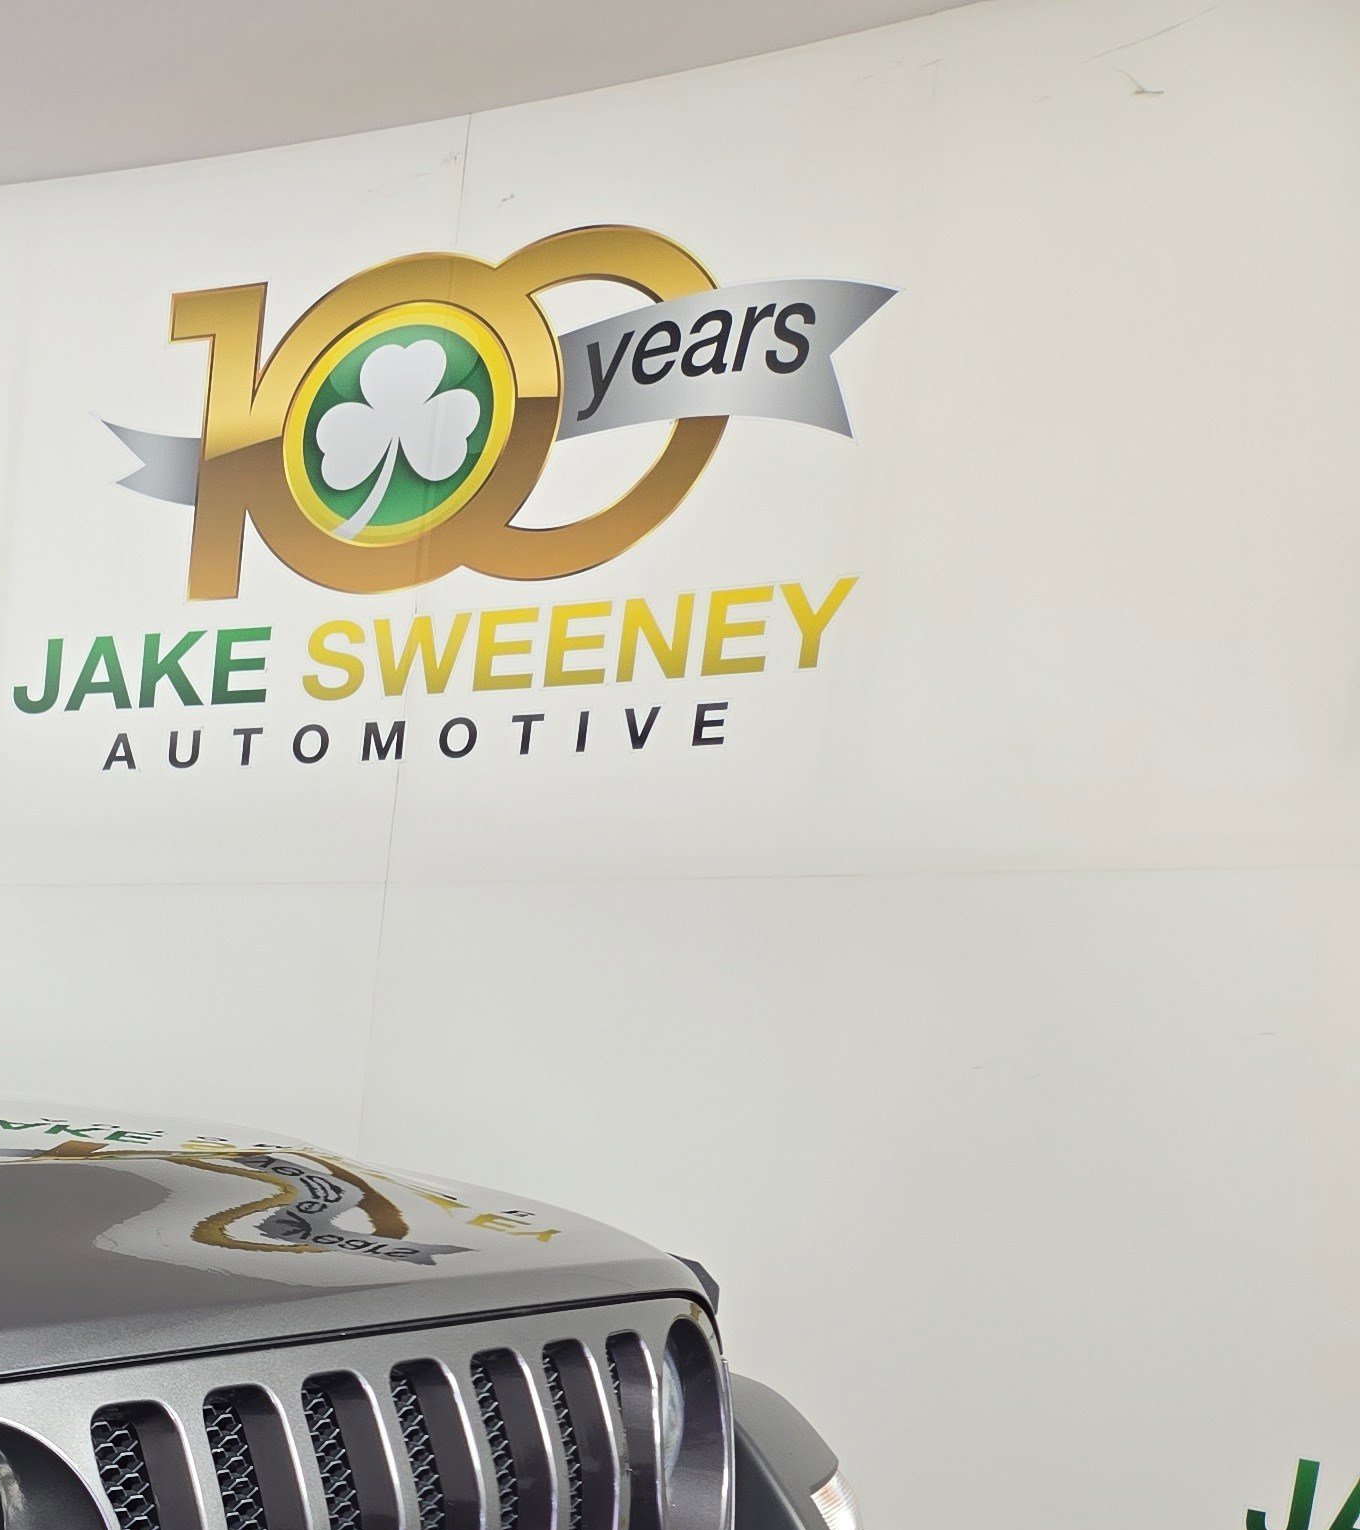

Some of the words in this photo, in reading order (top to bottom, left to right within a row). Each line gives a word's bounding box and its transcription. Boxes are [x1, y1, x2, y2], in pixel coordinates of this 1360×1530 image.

[168, 223, 730, 601] 100
[576, 298, 817, 421] years
[11, 625, 273, 715] JAKE
[301, 576, 860, 702] SWEENEY
[102, 701, 730, 771] AUTOMOTIVE
